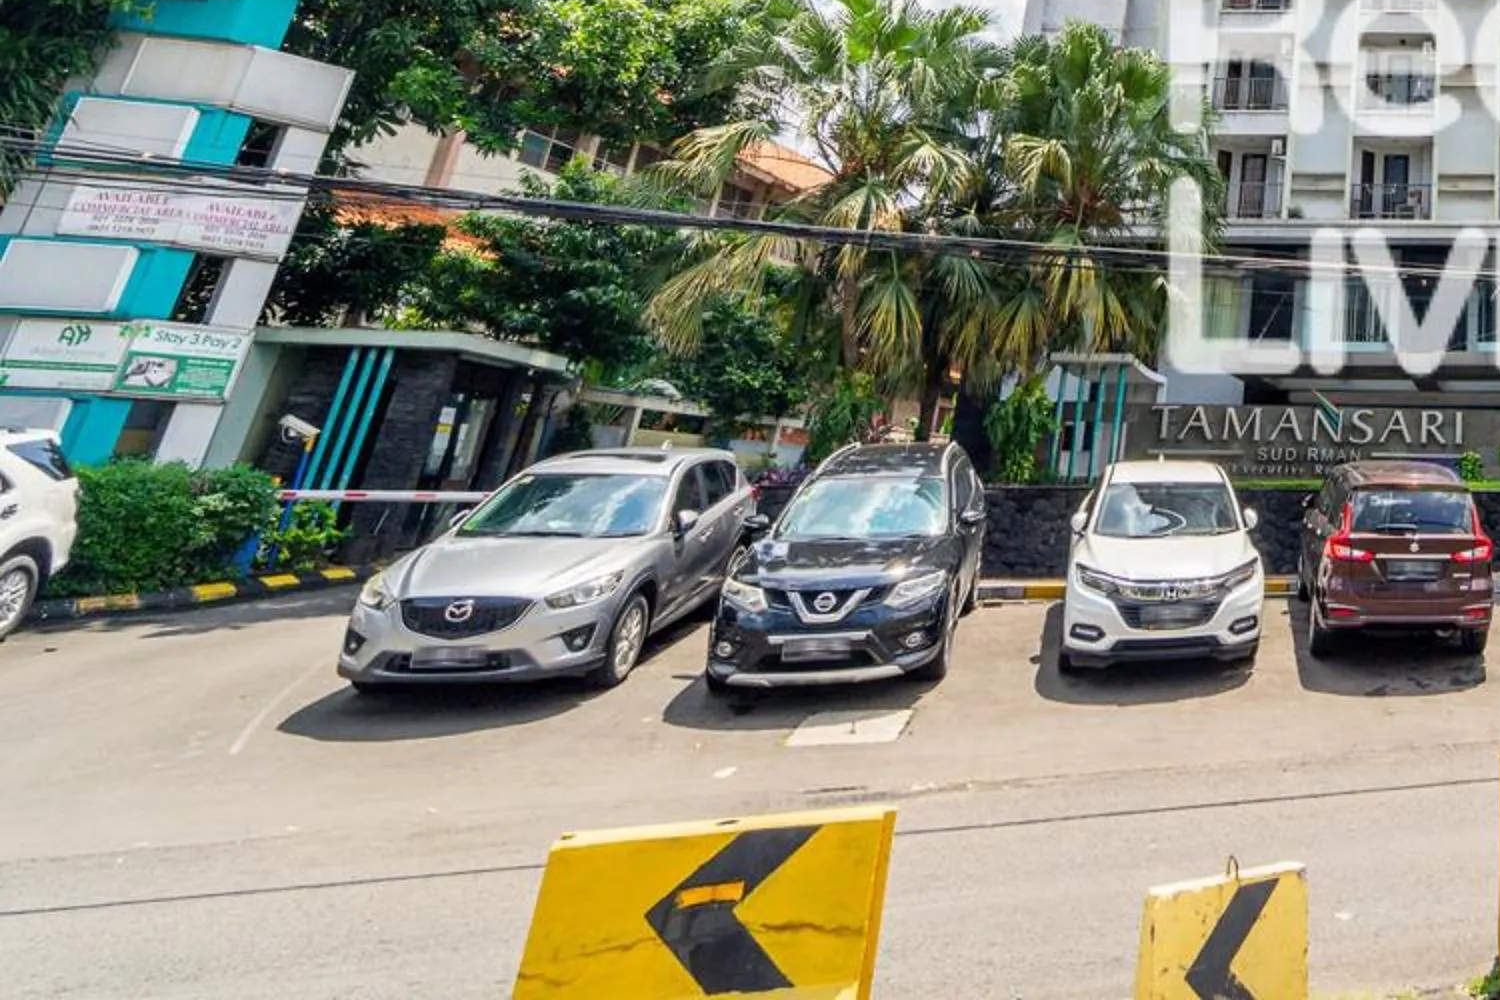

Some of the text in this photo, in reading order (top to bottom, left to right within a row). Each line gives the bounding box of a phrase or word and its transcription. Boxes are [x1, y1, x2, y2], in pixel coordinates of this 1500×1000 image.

[96, 191, 170, 206] AVAILABLE
[207, 203, 276, 221] AVAILABLE
[155, 329, 187, 344] Stay
[189, 333, 200, 345] 3
[202, 334, 227, 349] Pay
[1152, 404, 1464, 445] TAMANSARI
